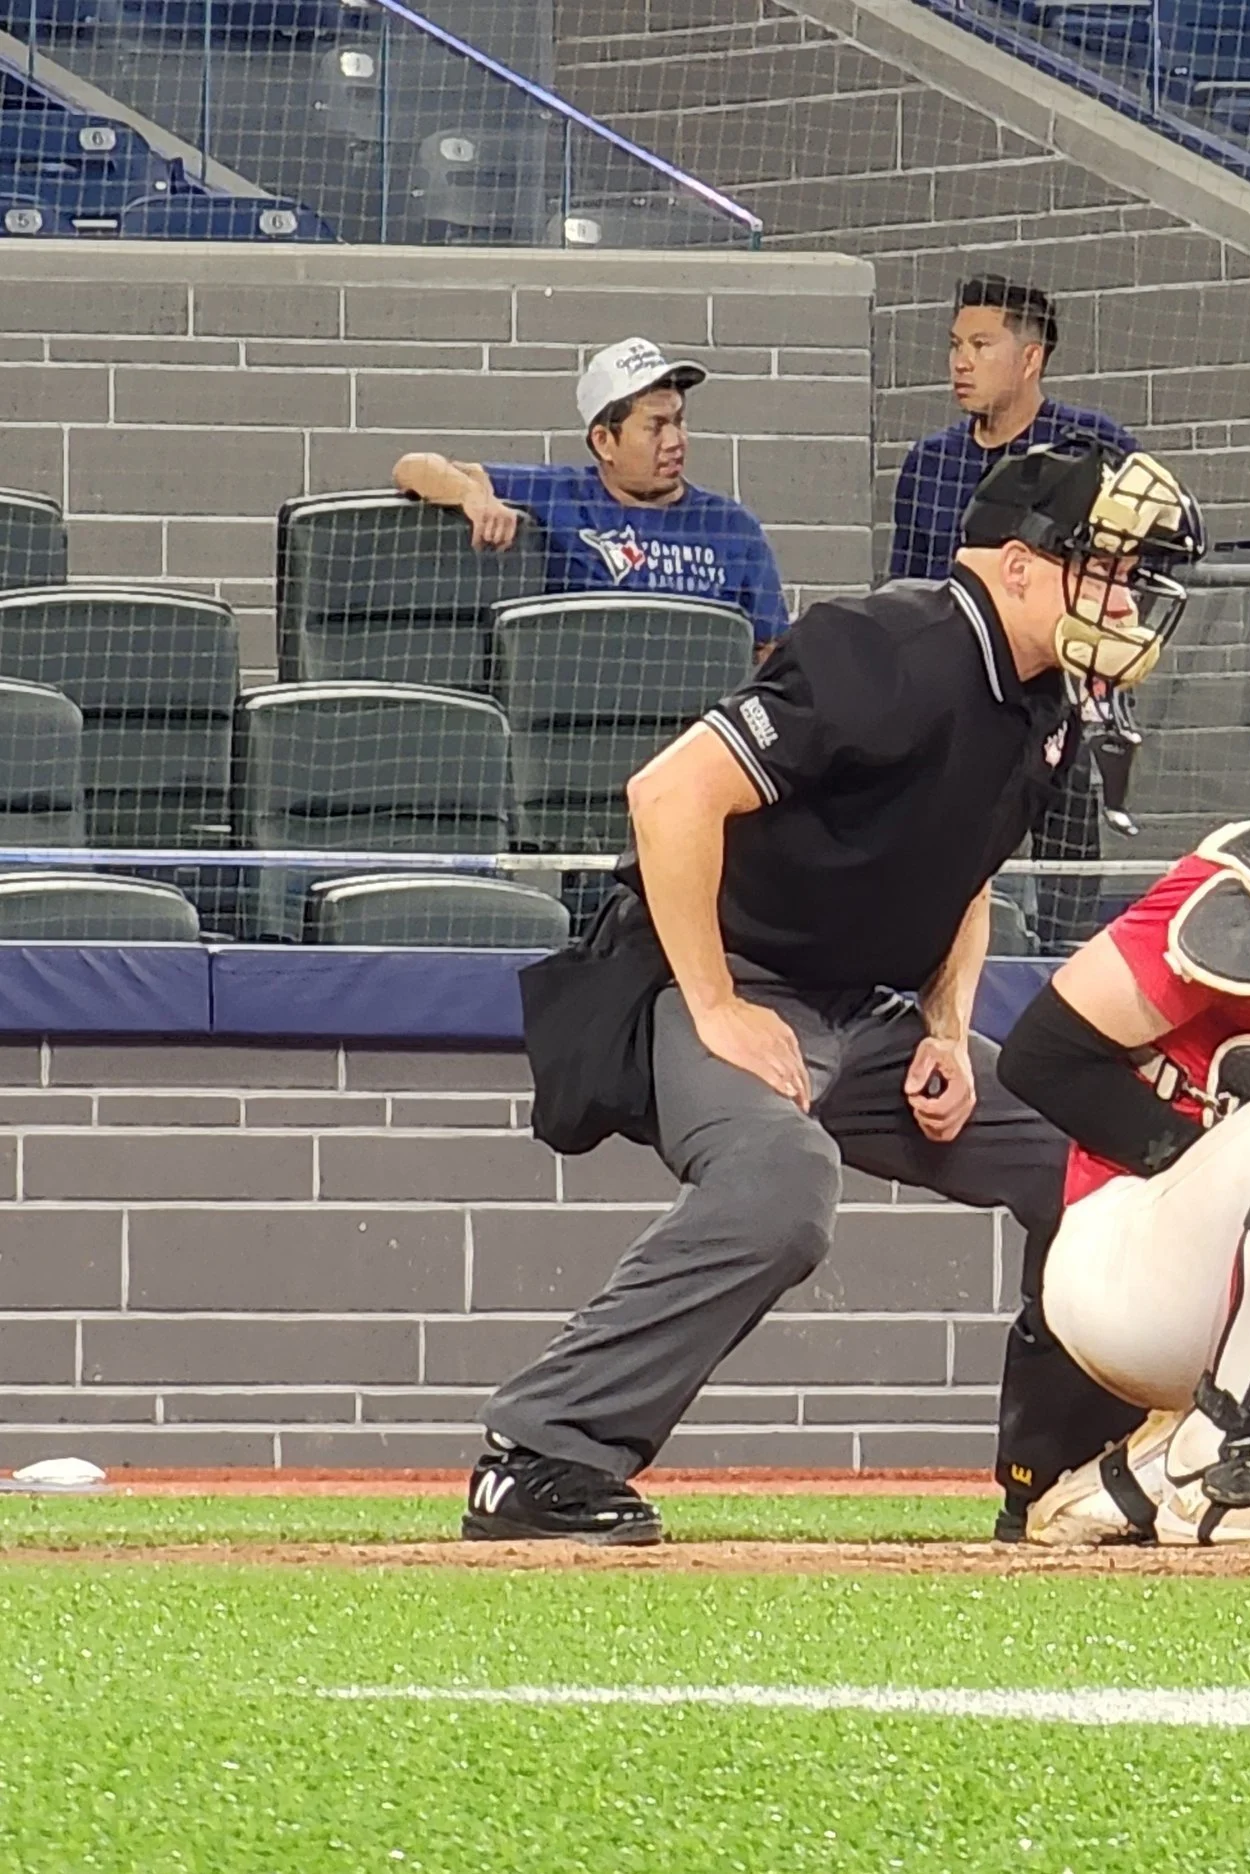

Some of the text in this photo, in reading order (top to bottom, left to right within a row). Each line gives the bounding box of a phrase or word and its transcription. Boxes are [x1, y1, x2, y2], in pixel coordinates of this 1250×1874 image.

[92, 131, 104, 146] 6
[18, 212, 30, 228] 5
[272, 214, 284, 230] 6
[474, 1469, 516, 1514] N
